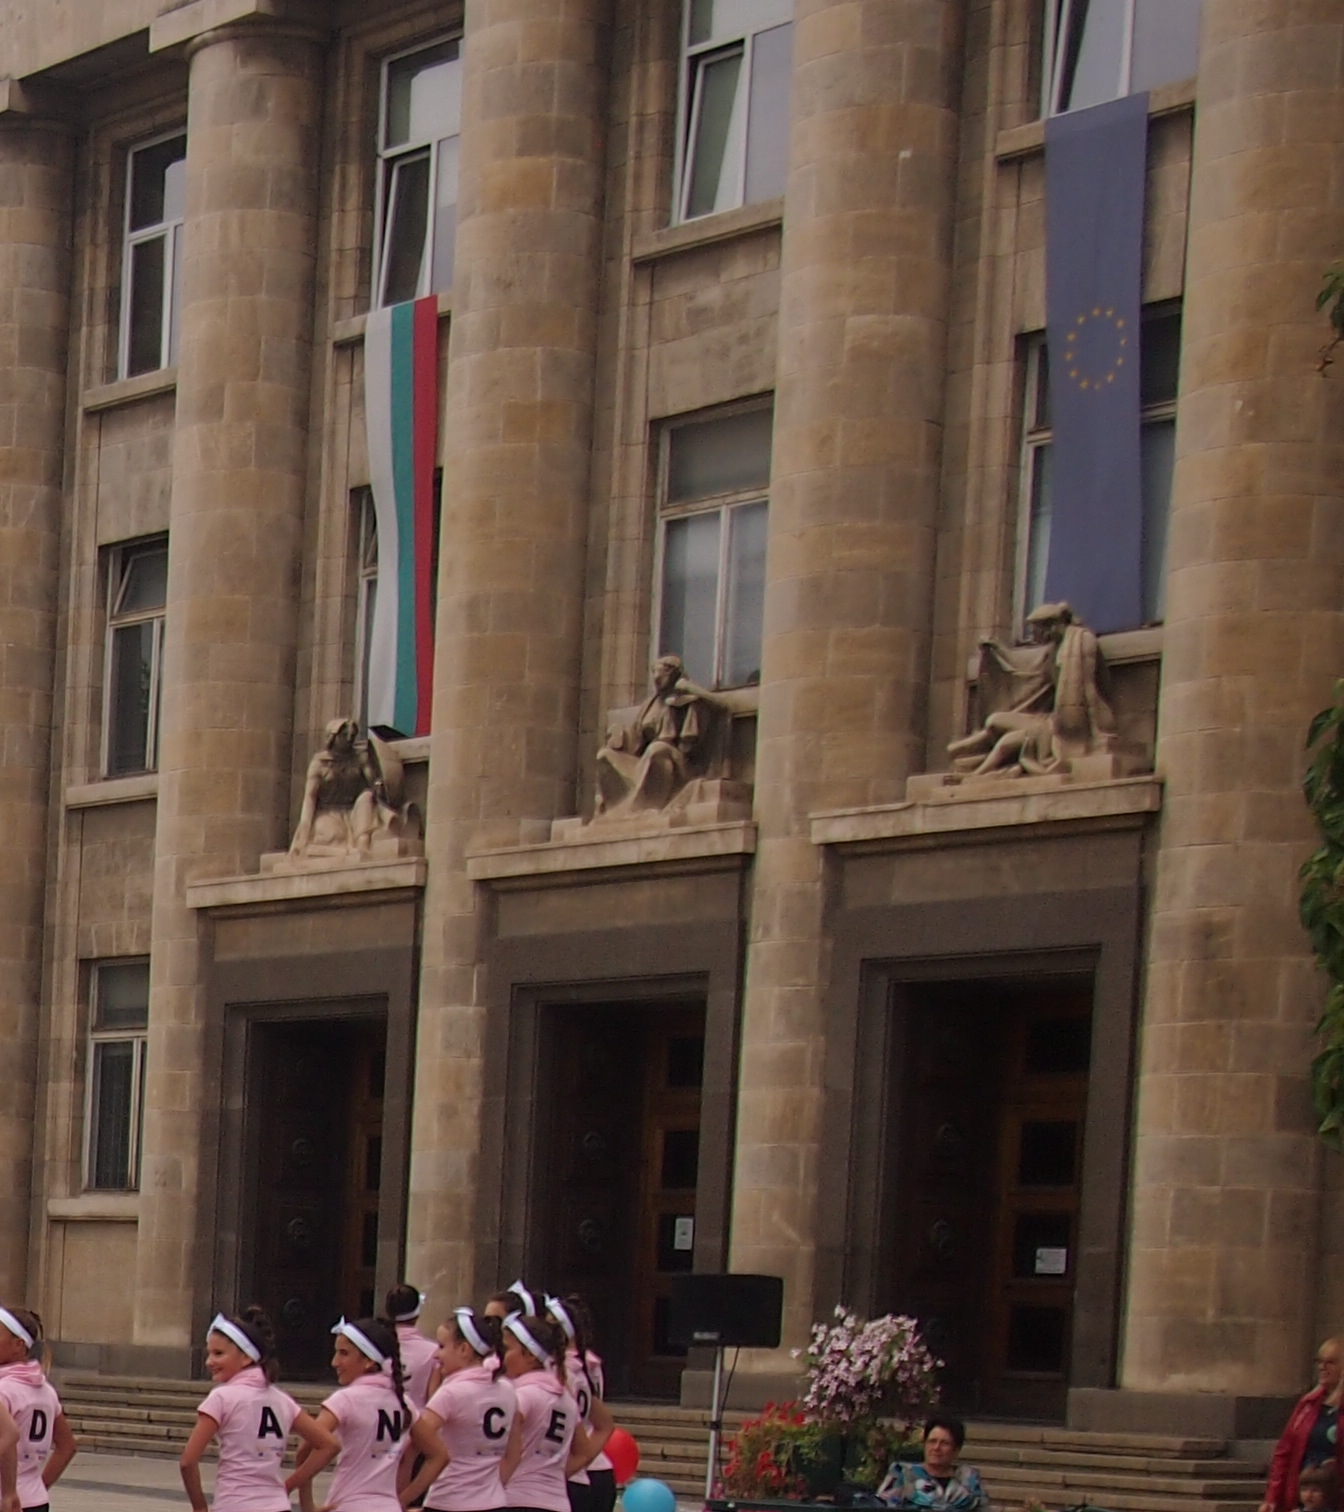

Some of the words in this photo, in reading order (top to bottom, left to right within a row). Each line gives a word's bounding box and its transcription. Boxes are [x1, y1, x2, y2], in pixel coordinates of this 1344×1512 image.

[29, 1409, 47, 1442] D
[258, 1406, 283, 1439] A
[376, 1409, 402, 1442] N
[482, 1407, 506, 1440] C
[545, 1409, 567, 1444] E
